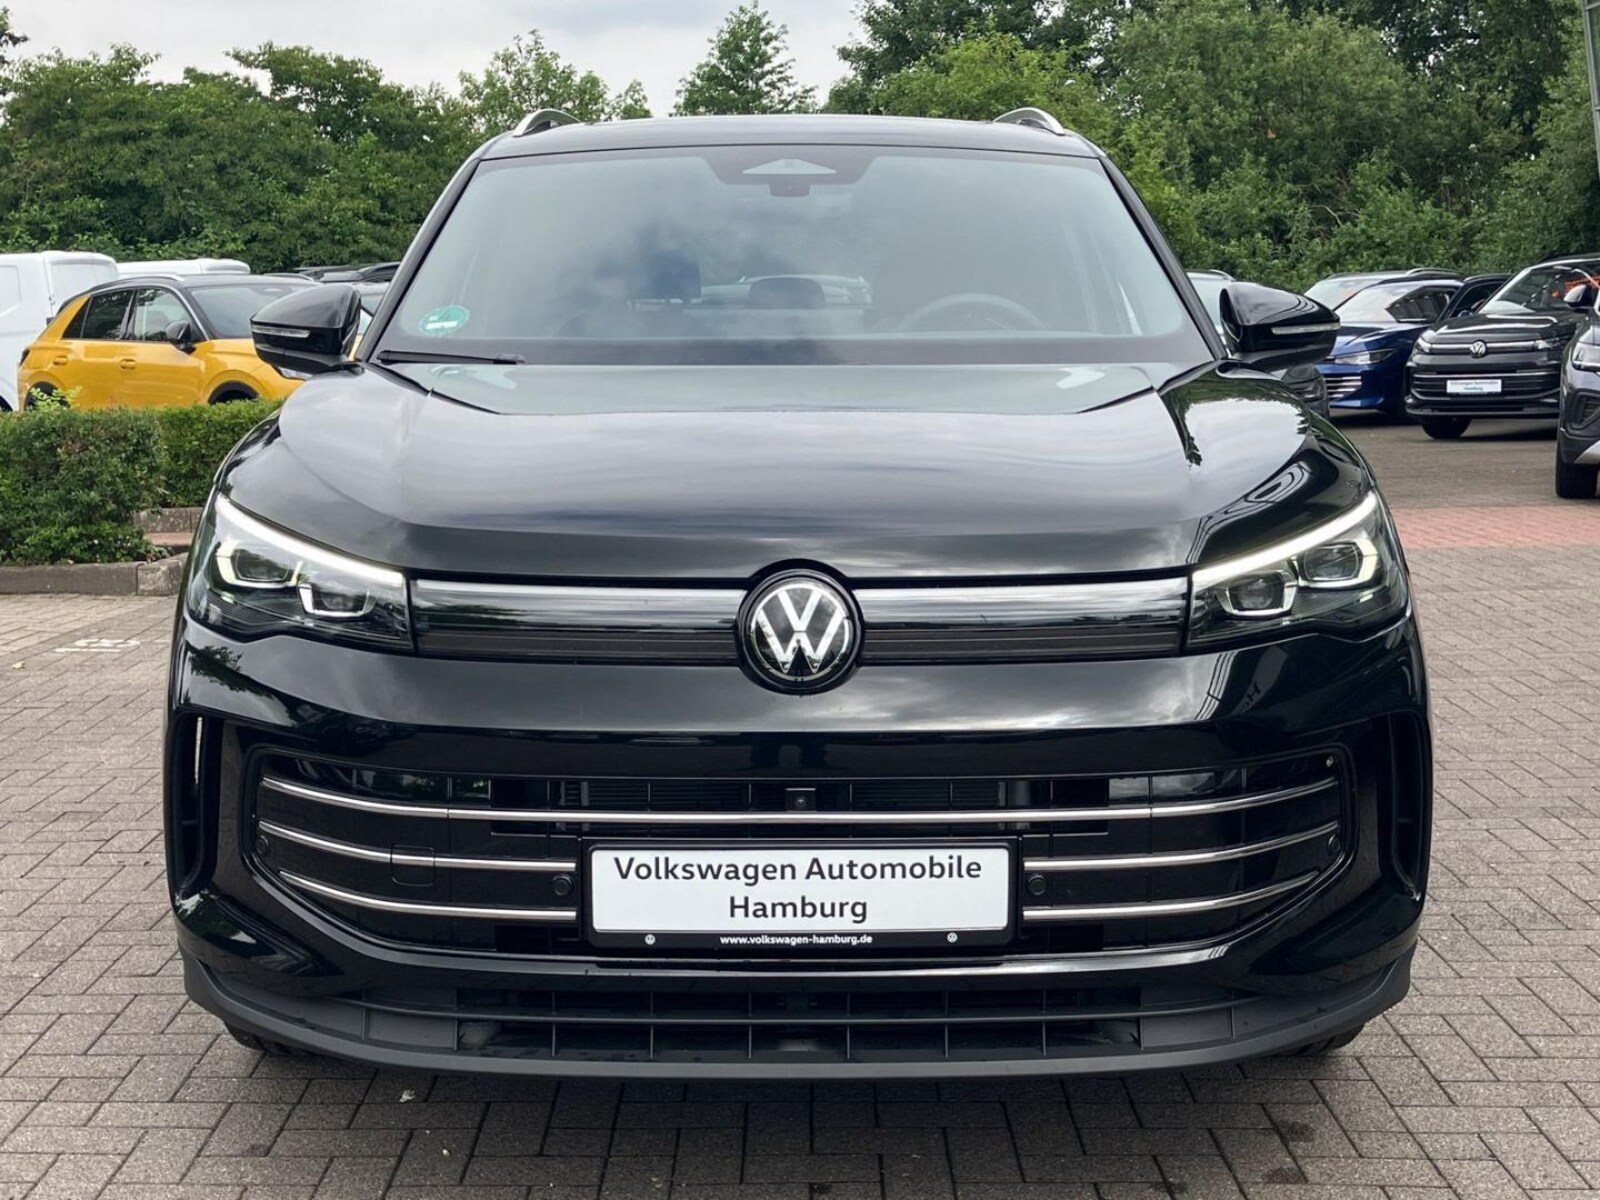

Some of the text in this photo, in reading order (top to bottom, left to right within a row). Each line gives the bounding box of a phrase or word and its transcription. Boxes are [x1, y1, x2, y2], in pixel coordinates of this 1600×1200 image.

[755, 586, 844, 674] VW
[613, 855, 982, 886] Volkswagen Automobile
[729, 895, 868, 924] Hamburg
[719, 934, 873, 946] www.volkswagen-hamburg.de
